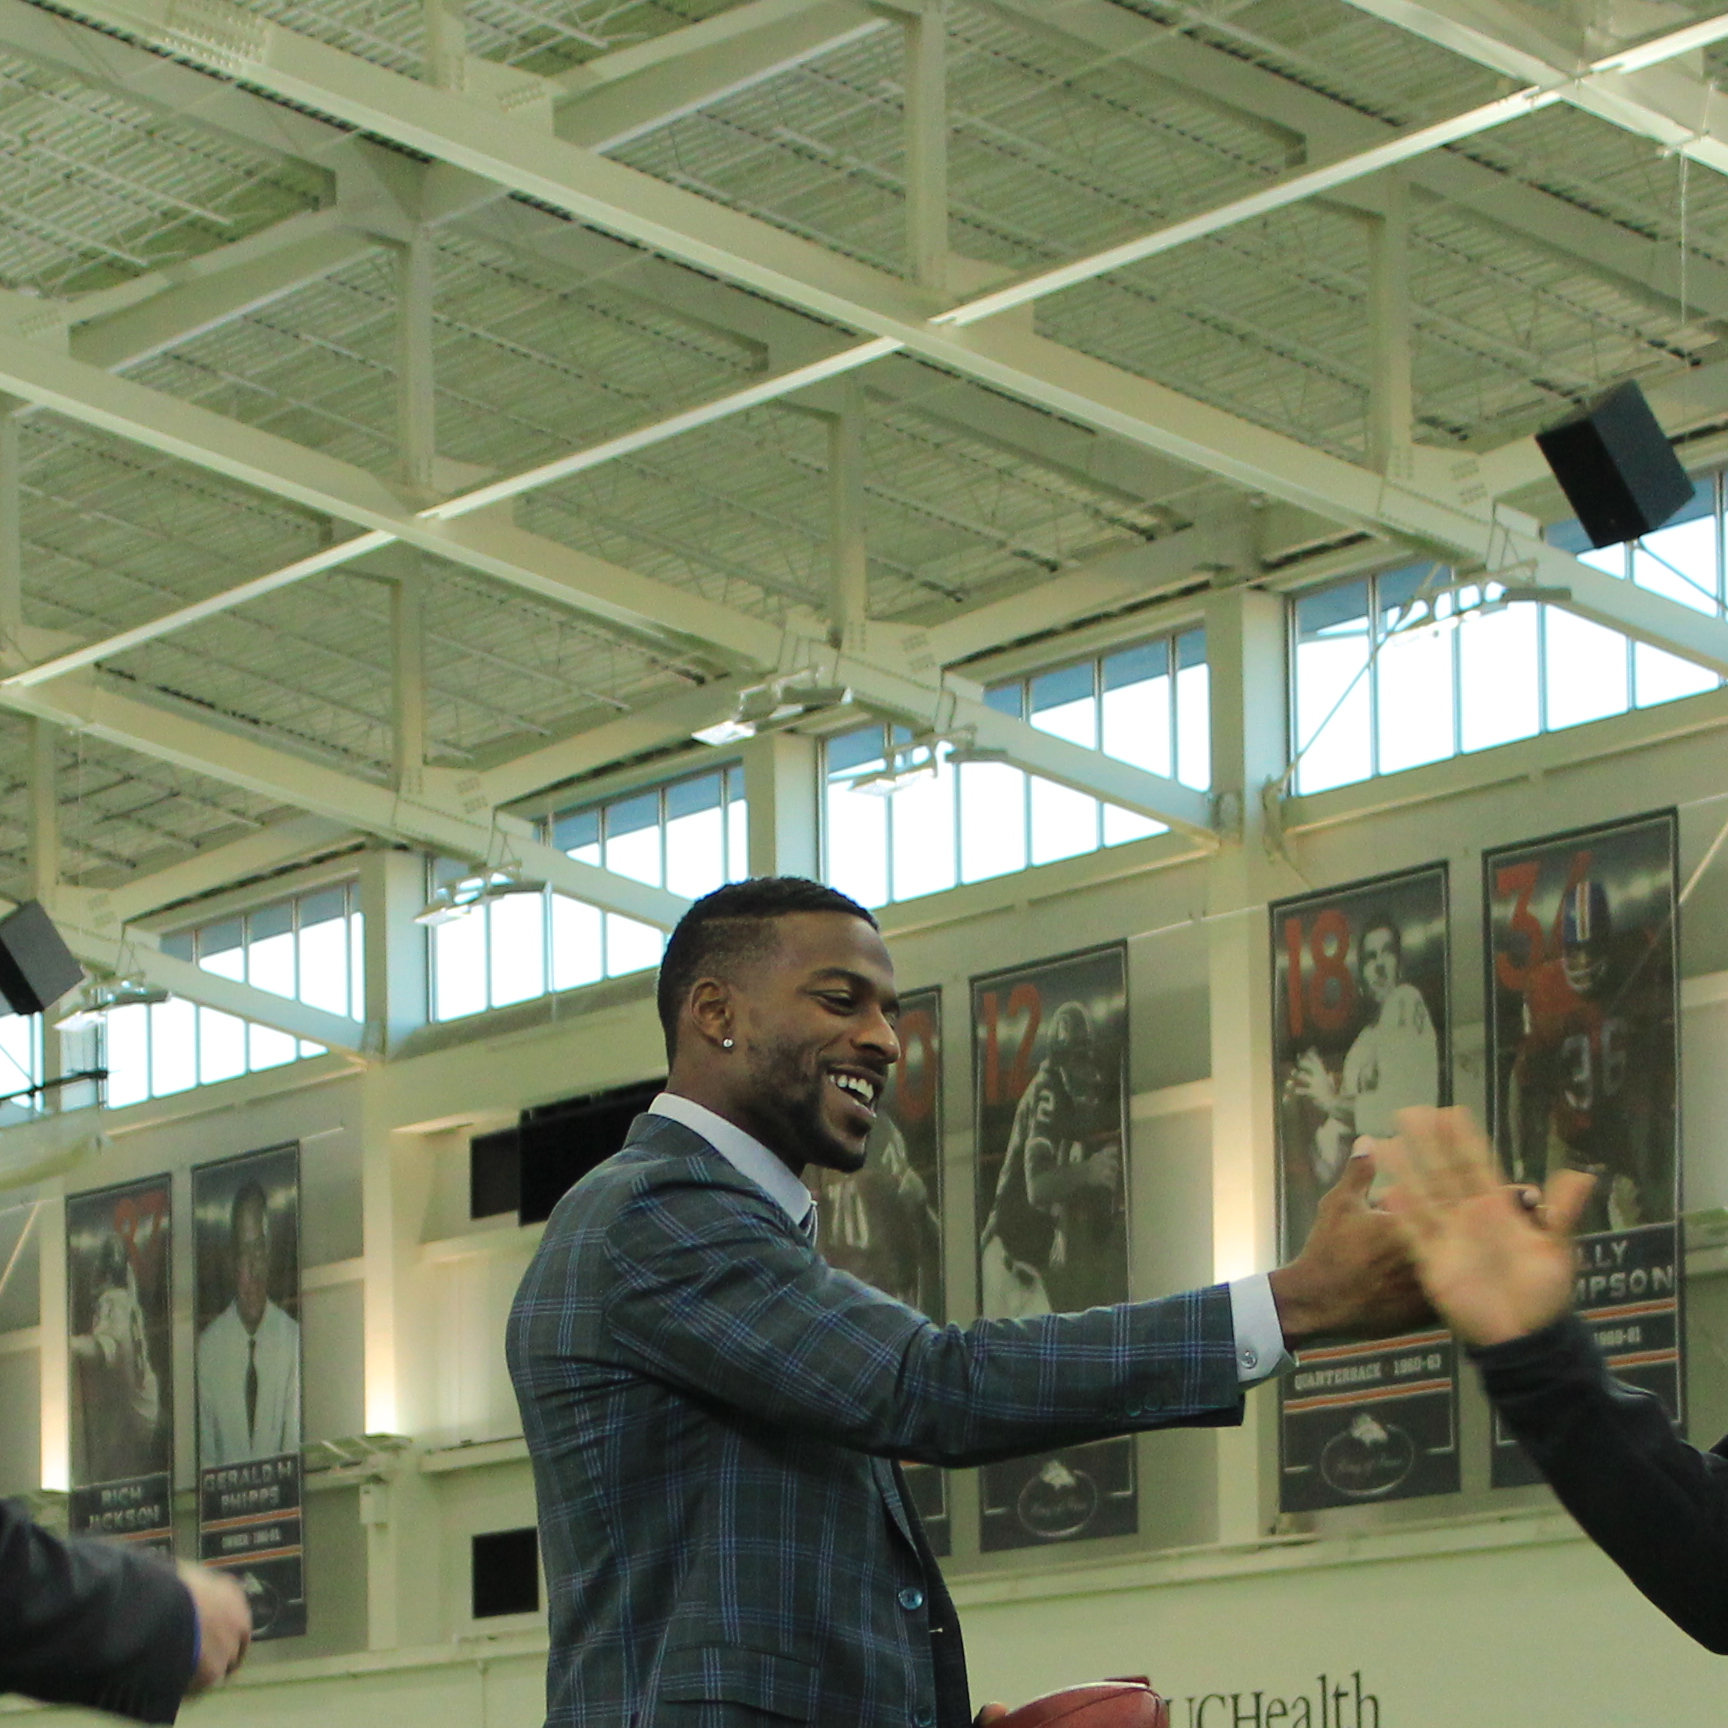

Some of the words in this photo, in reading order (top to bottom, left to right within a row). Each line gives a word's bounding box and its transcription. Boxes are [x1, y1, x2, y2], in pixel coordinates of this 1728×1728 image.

[1285, 910, 1357, 1037] 18
[983, 983, 1041, 1106] 12
[1574, 1264, 1675, 1299] PSON
[1576, 1240, 1629, 1270] LLY
